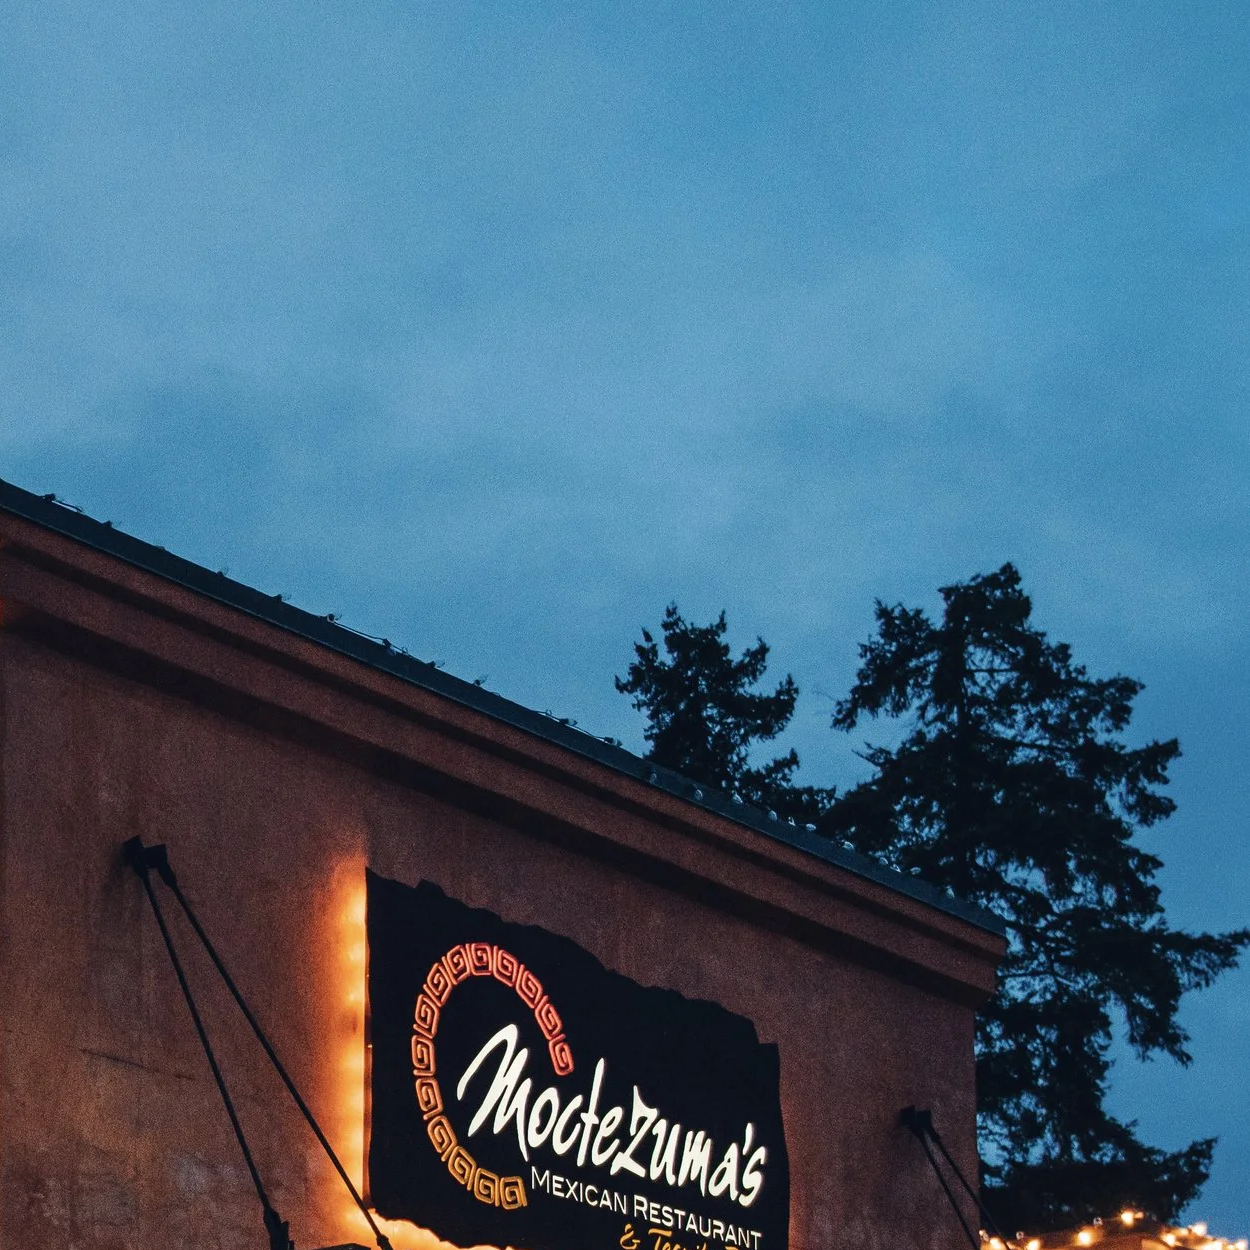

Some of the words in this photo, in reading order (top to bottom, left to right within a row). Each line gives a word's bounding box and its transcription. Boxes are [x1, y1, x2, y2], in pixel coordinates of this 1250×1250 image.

[531, 1166, 627, 1214] MEXICAN
[633, 1193, 762, 1250] RESTAURANT
[619, 1223, 641, 1250] &
